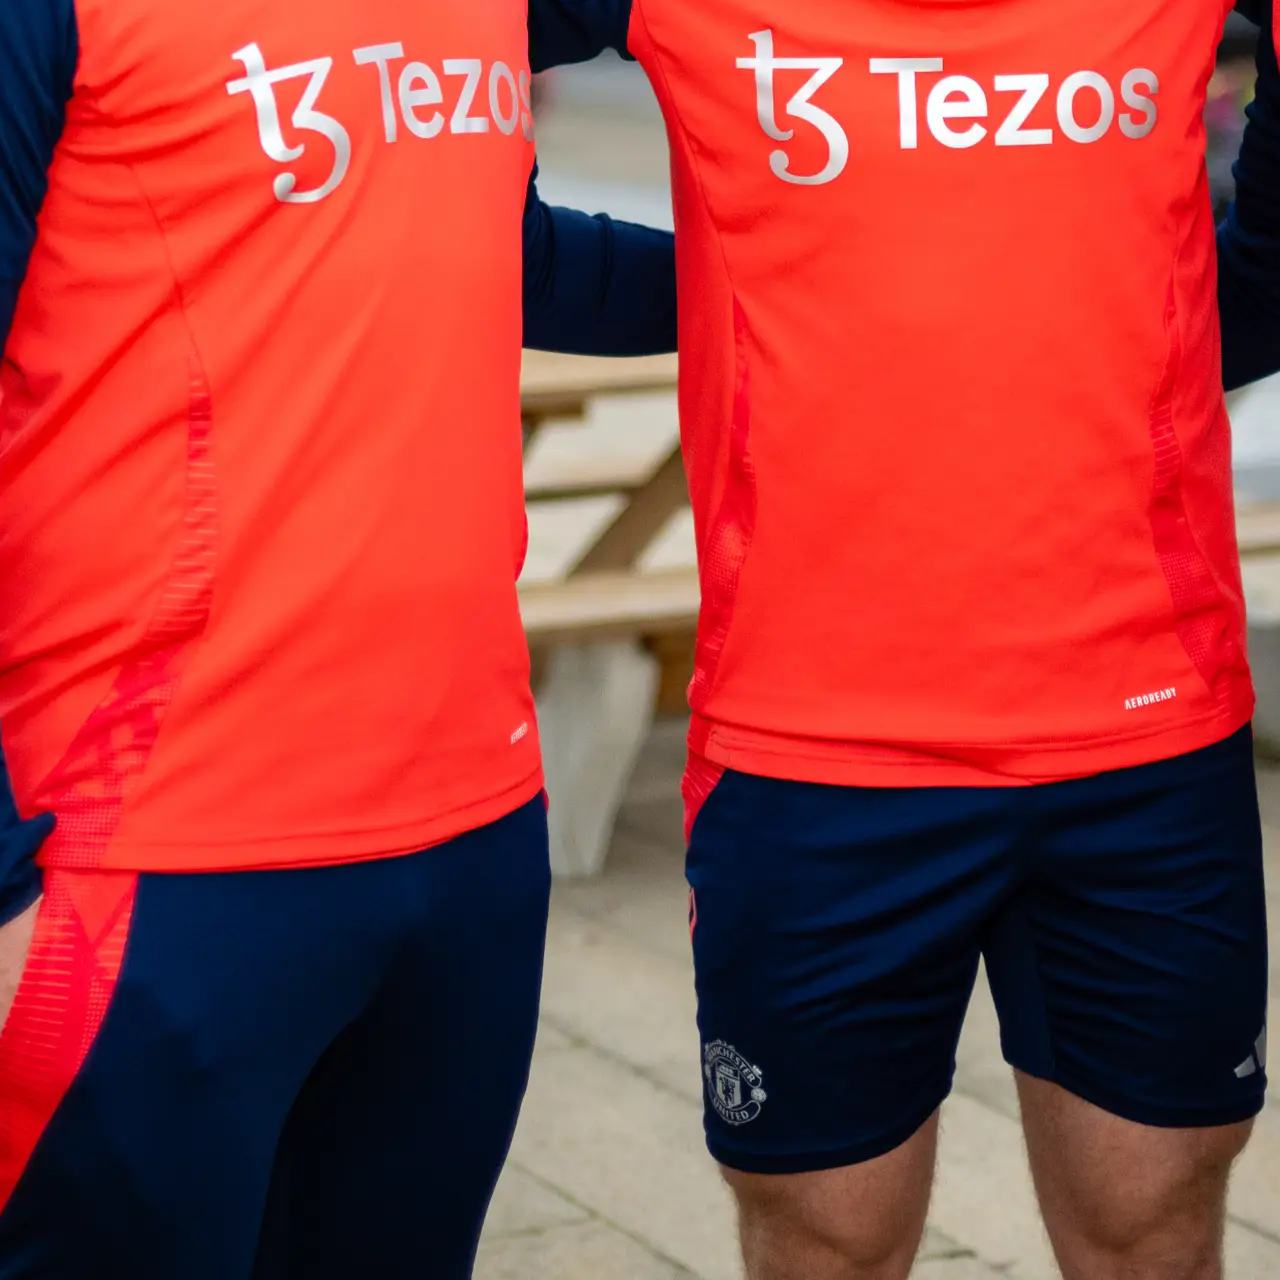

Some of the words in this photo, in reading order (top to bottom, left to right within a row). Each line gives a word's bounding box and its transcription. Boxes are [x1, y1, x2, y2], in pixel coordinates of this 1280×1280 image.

[352, 42, 534, 143] Tezos
[869, 57, 1159, 149] Tezos
[1125, 687, 1177, 710] AEROREADY
